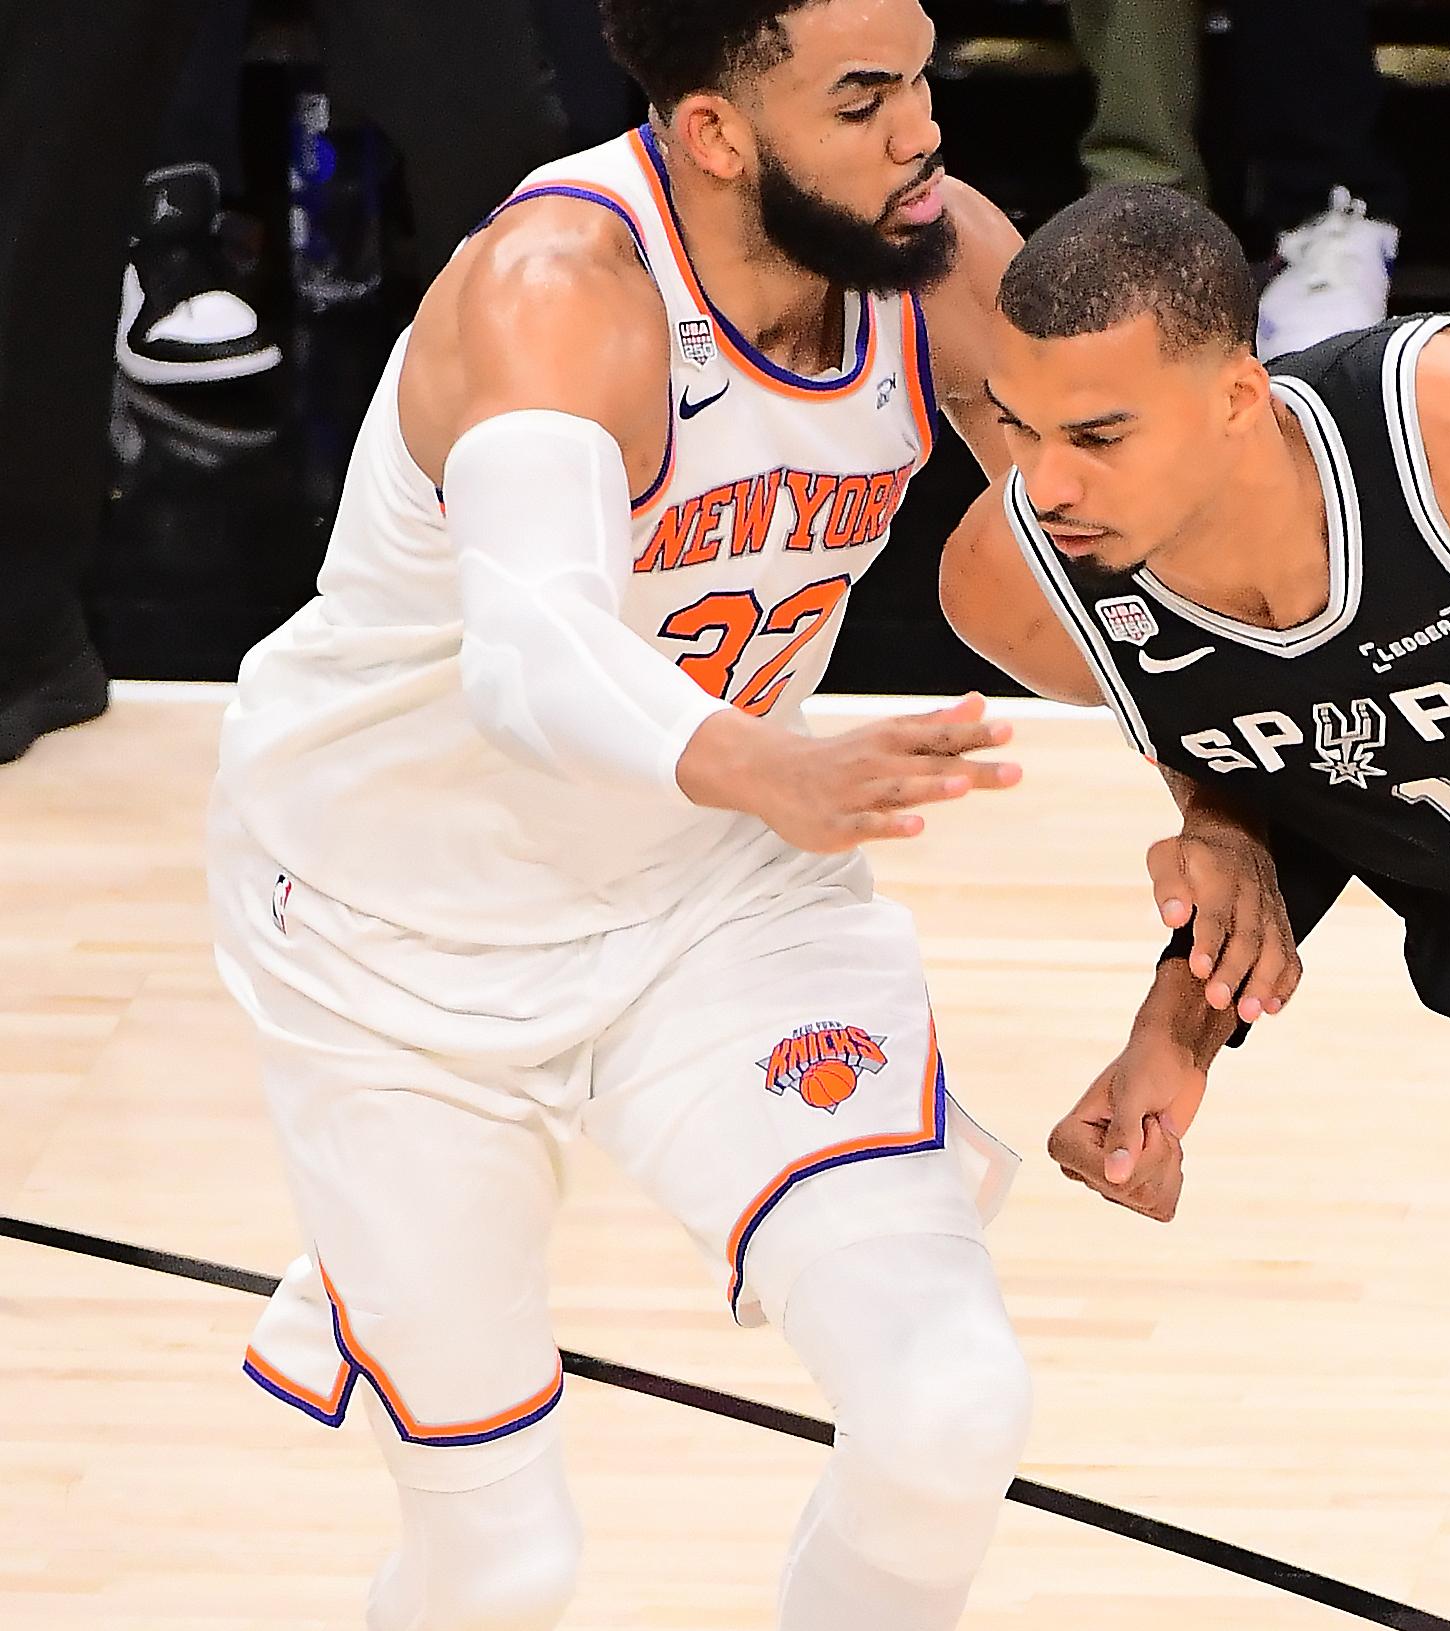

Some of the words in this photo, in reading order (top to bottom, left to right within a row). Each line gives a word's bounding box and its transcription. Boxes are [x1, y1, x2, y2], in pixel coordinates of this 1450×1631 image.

[632, 467, 781, 574] NEW
[657, 573, 851, 717] 32
[765, 1025, 888, 1096] KNICKS
